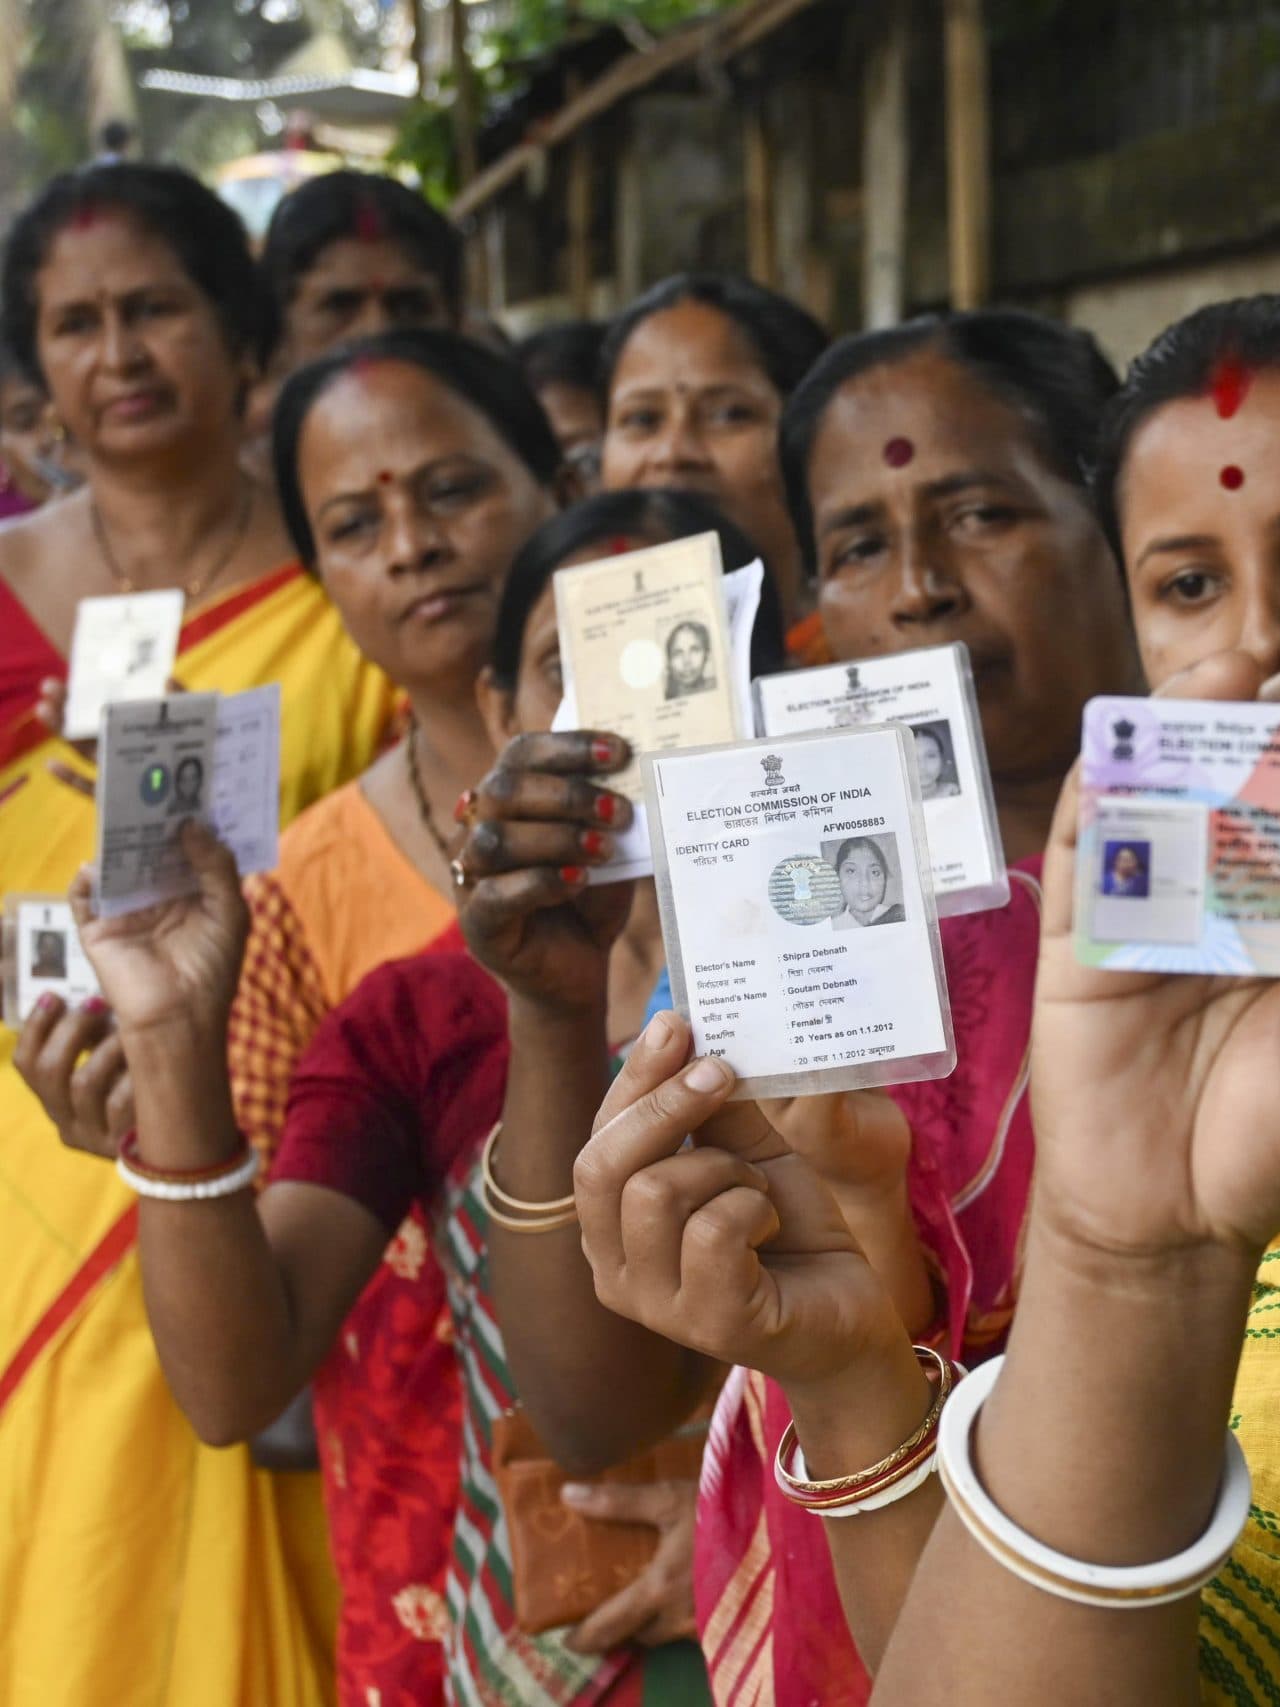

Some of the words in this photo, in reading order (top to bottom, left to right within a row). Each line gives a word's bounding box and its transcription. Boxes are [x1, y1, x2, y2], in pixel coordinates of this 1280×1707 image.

[686, 807, 742, 822] ELECTION
[744, 795, 818, 814] COMMISSION
[821, 792, 836, 803] OF
[839, 787, 872, 800] INDIA
[823, 816, 886, 833] AFW0058883
[675, 841, 719, 856] IDENTITY
[721, 838, 750, 849] CARD
[782, 951, 810, 962] Shipra
[812, 945, 848, 958] Debnath
[695, 961, 730, 973] Elector's
[732, 959, 756, 969] Name
[787, 984, 821, 995] Goutam
[822, 978, 858, 990] Debnath
[699, 994, 742, 1007] Husband's
[743, 991, 767, 1001] Name
[808, 1031, 833, 1042] Years
[846, 1029, 858, 1037] on
[859, 1022, 894, 1035] 1.1.2012
